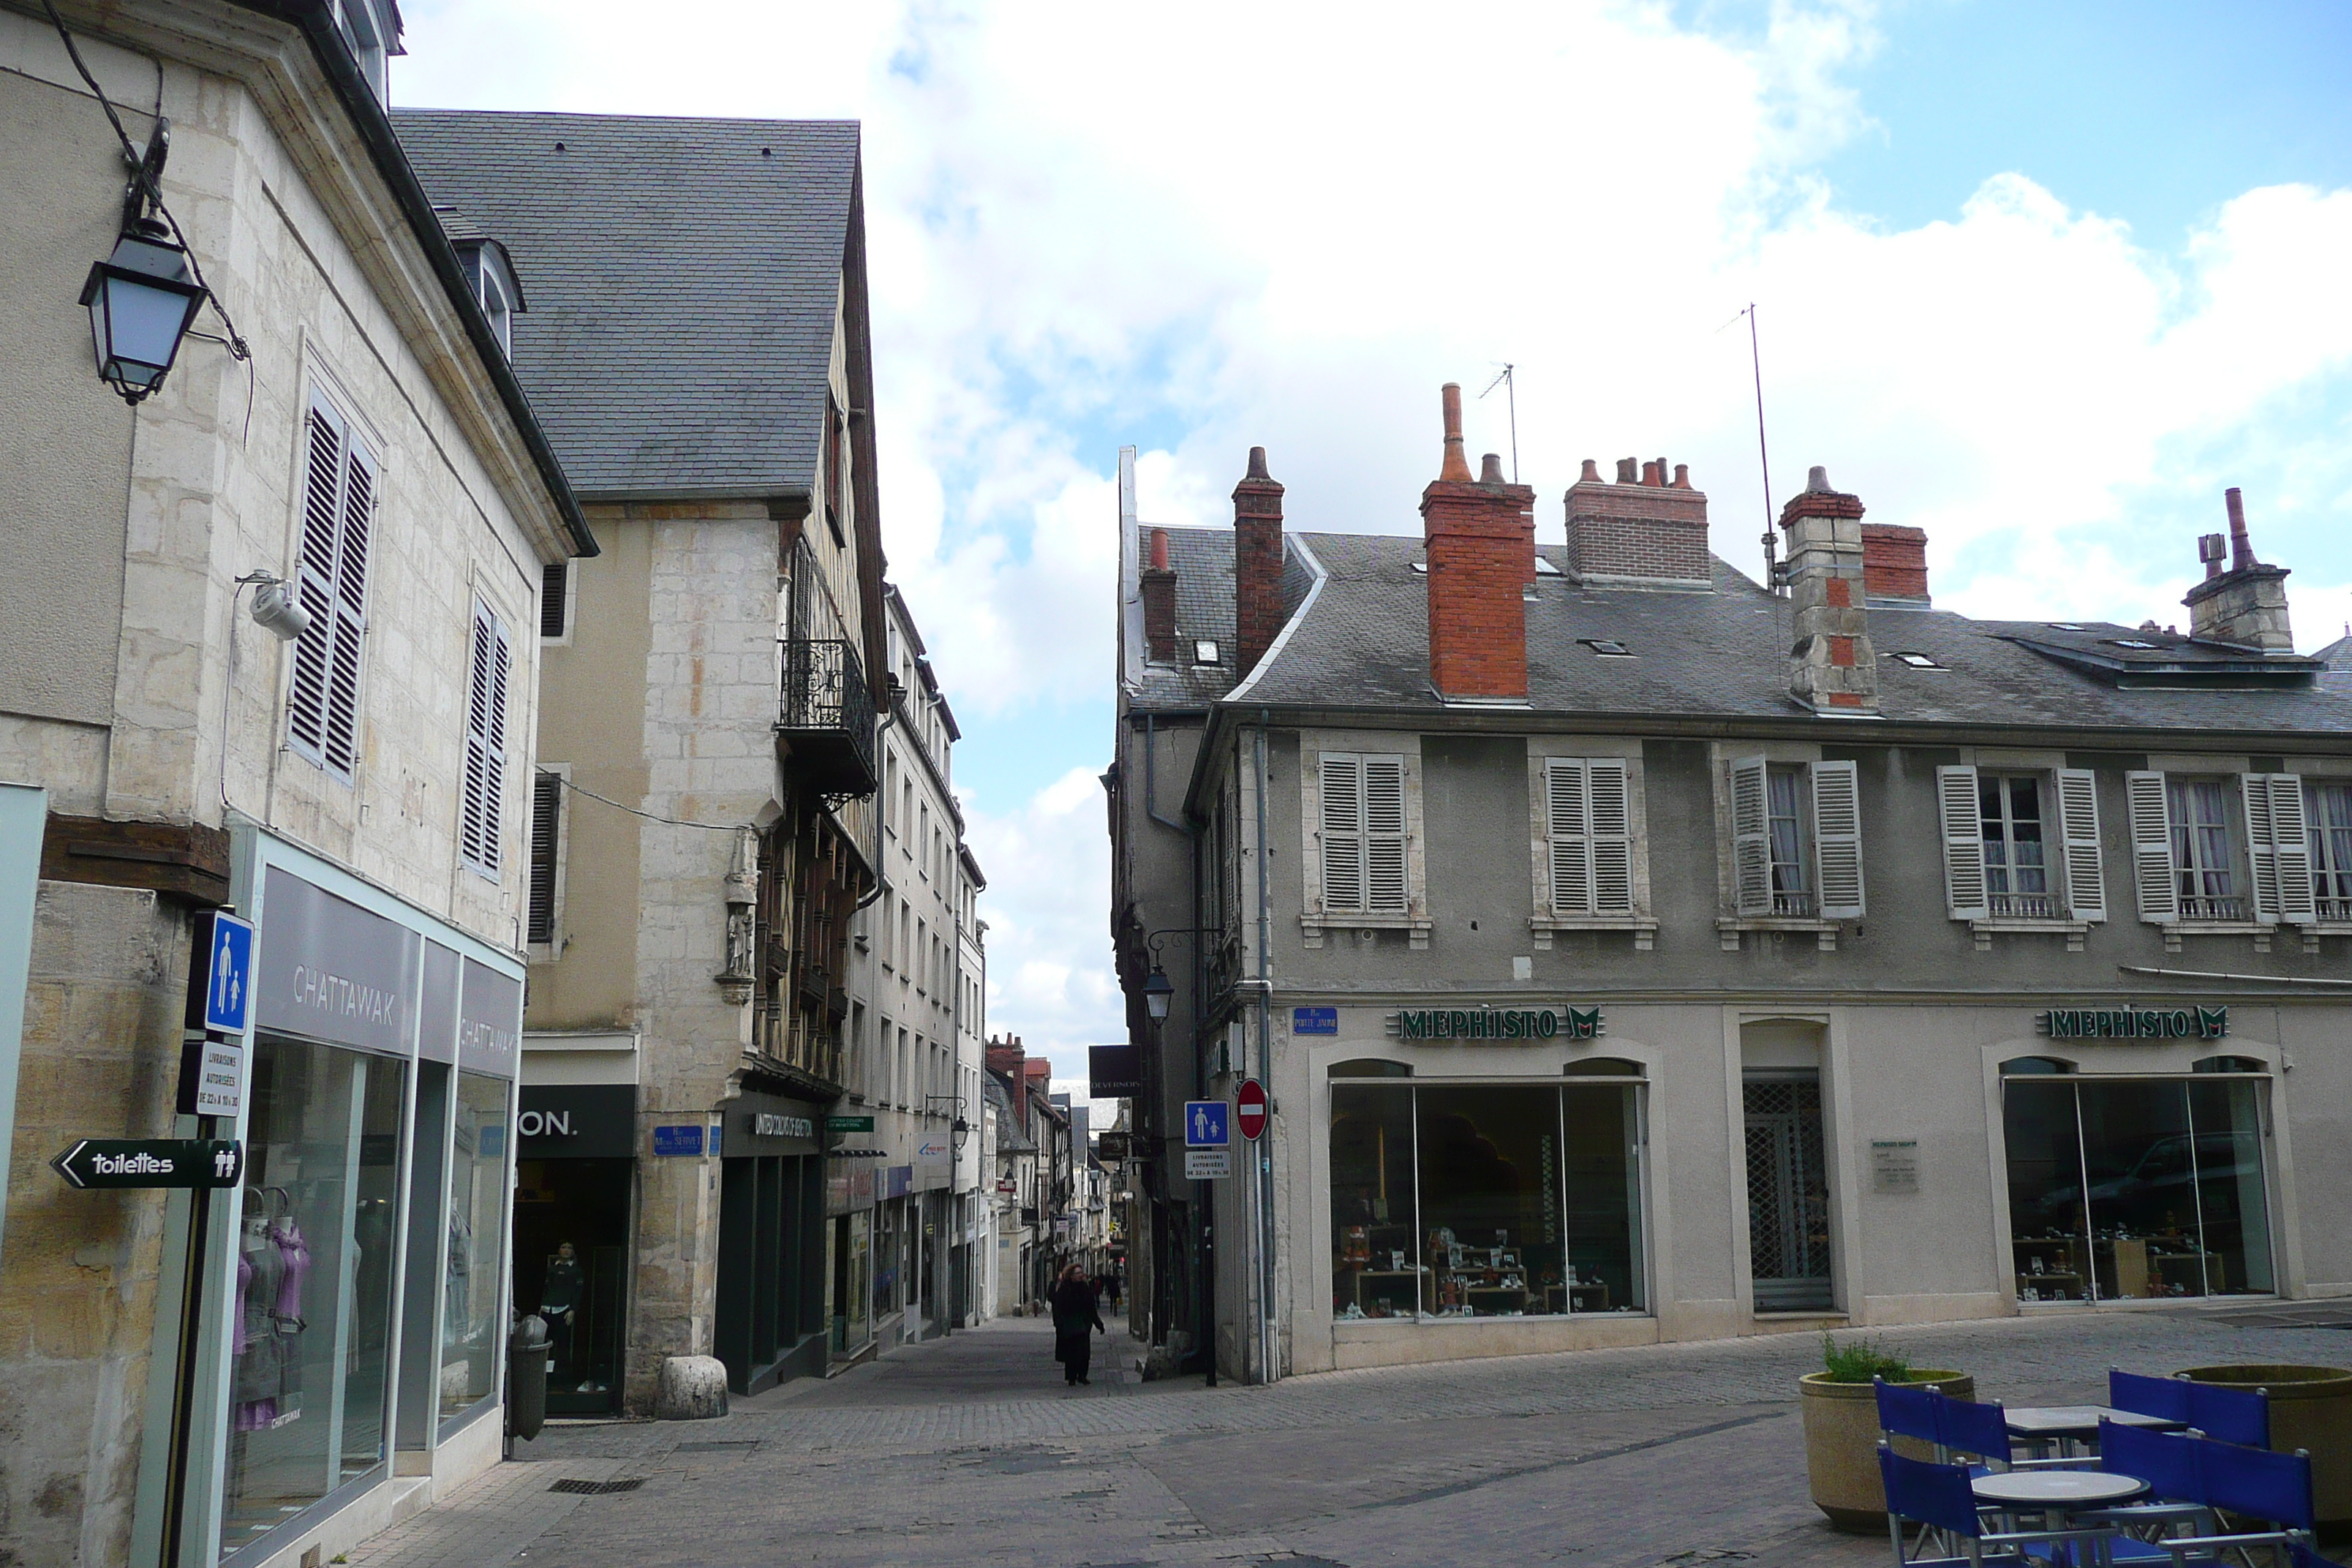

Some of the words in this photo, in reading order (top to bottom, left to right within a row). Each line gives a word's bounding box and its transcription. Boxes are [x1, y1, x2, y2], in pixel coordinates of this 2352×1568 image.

[294, 965, 395, 1026] CHATTAWAK
[1399, 1009, 1558, 1039] MEPHISTO
[2048, 1010, 2191, 1038] MEPHISTO
[461, 1017, 516, 1058] CHATTAWAK
[208, 1052, 236, 1067] LIVRAISONS
[1091, 1081, 1140, 1089] DEVERNOIS
[517, 1110, 578, 1136] ON.
[756, 1113, 772, 1134] UNITED
[773, 1115, 788, 1136] COLORS
[91, 1153, 174, 1174] toilettes
[271, 1408, 301, 1430] CHATTAWAK
